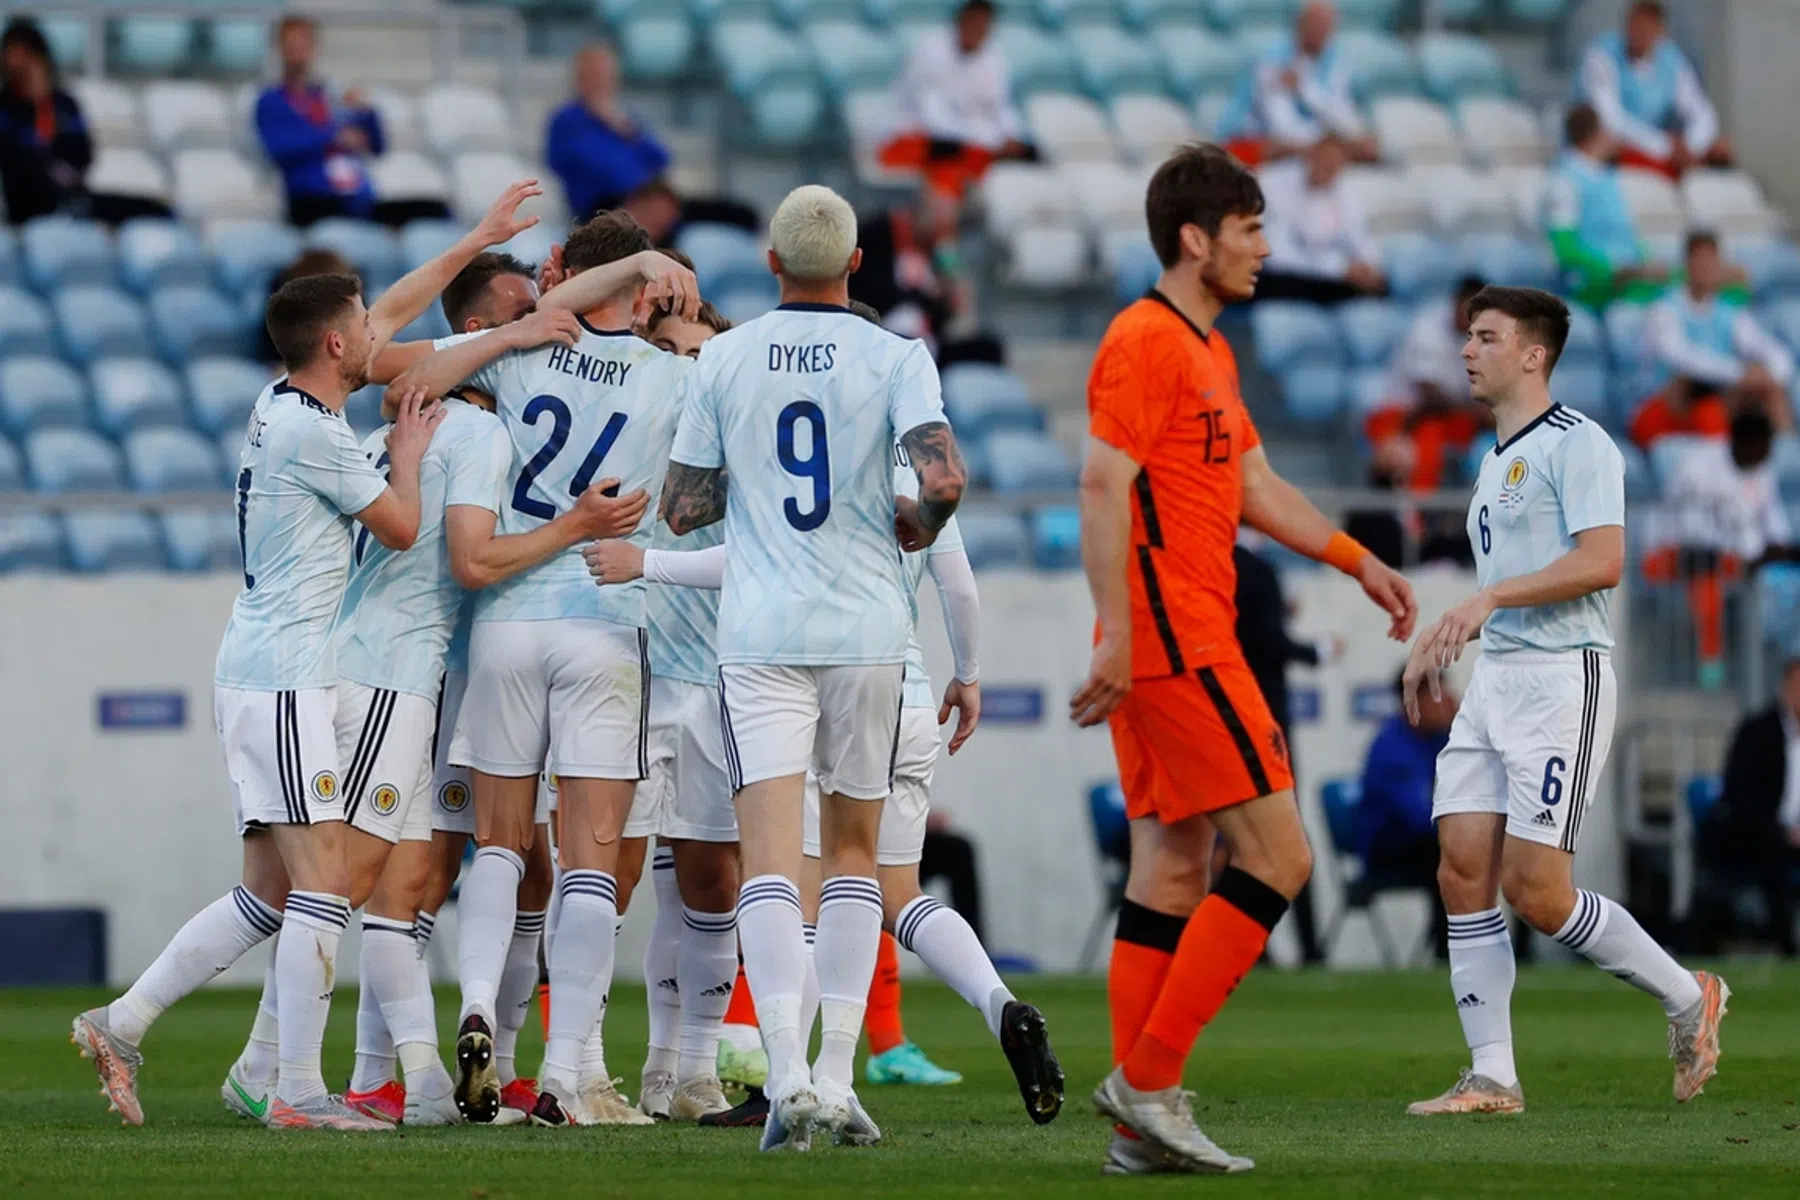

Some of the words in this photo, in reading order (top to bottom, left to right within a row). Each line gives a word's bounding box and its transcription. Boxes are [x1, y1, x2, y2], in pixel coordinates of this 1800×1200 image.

[547, 346, 632, 387] HENDRY
[768, 343, 837, 373] DYKES
[1197, 410, 1231, 464] 15
[777, 400, 831, 532] 9
[1478, 505, 1492, 555] 6
[1541, 756, 1566, 807] 6
